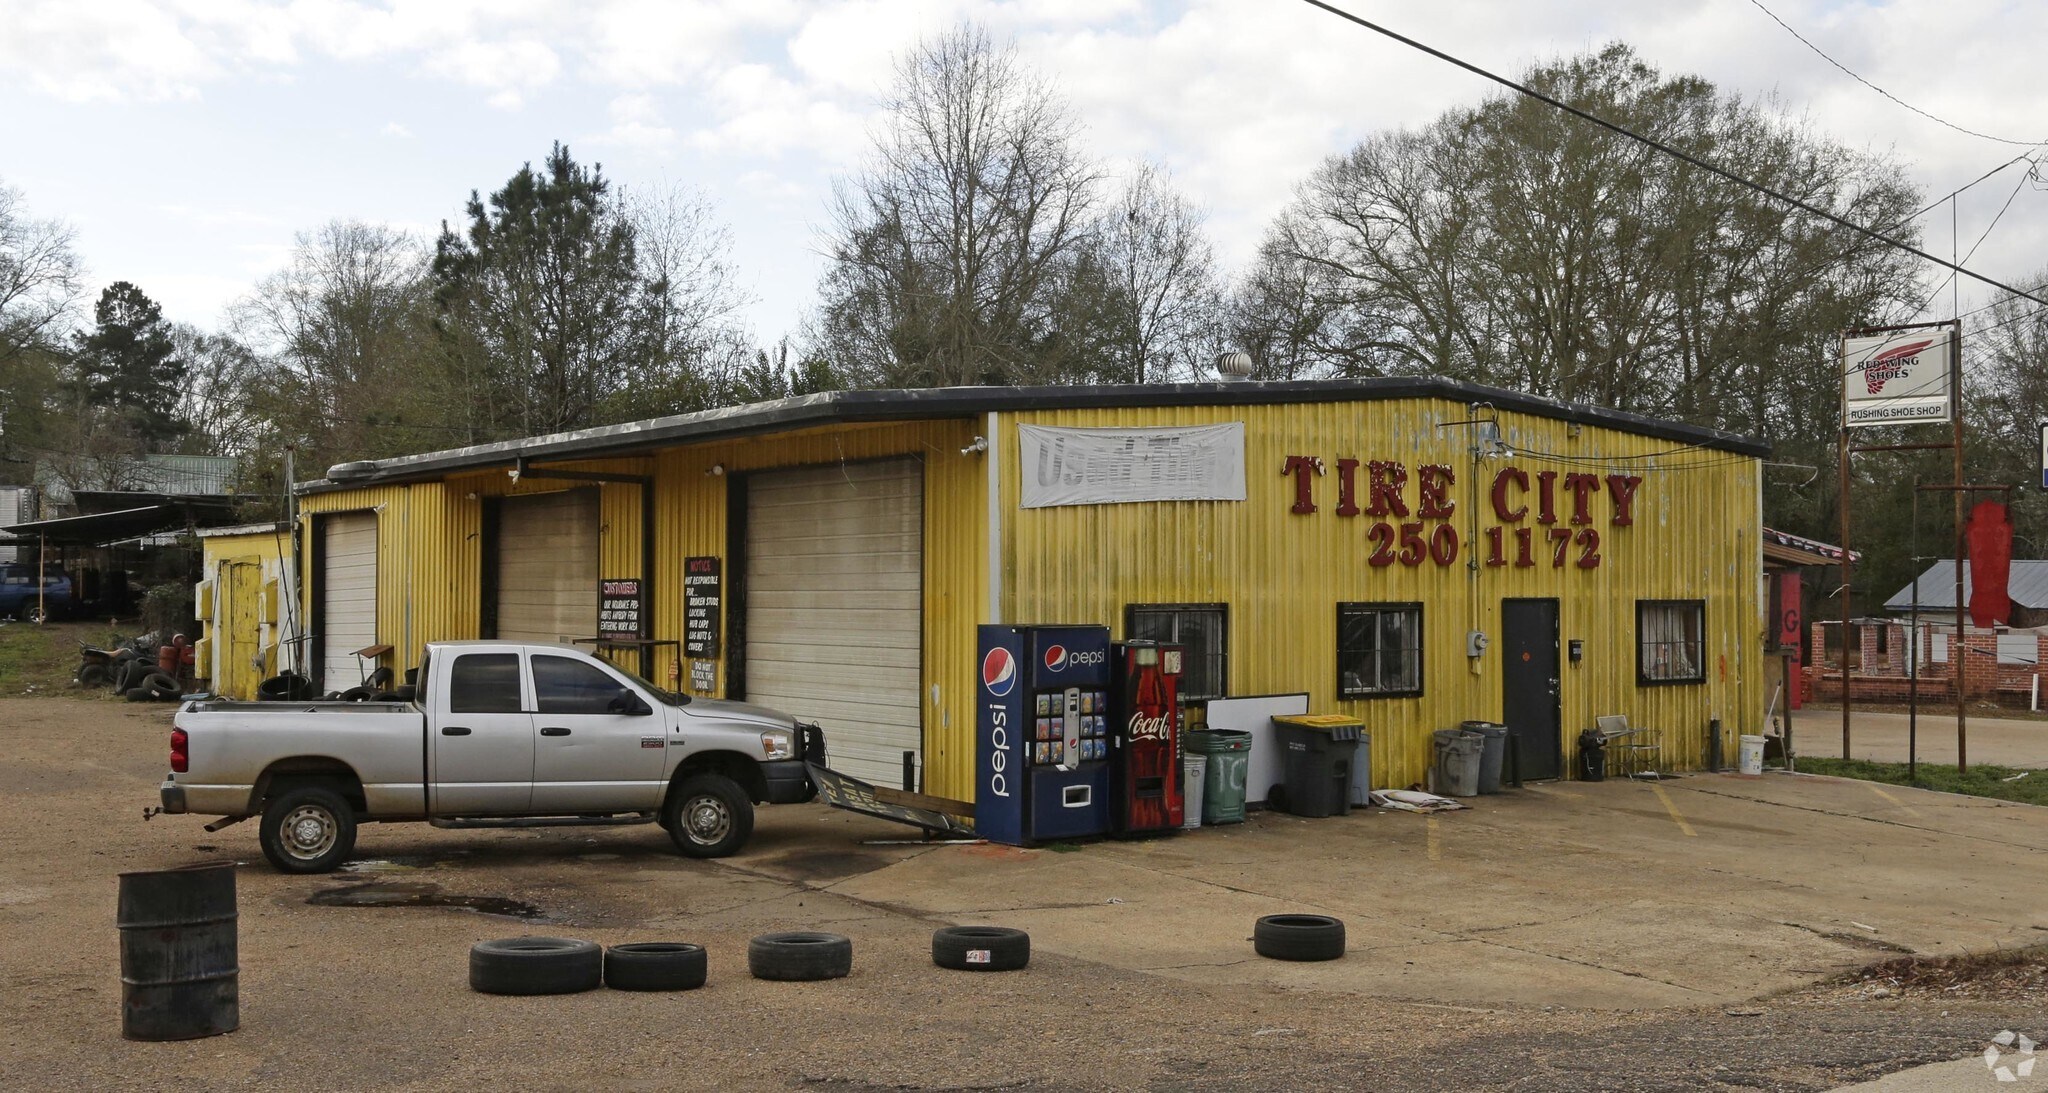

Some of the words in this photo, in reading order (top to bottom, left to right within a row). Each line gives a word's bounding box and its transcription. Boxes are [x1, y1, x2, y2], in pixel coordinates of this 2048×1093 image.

[1857, 360, 1881, 371] RED
[1884, 356, 1919, 369] WING
[1868, 369, 1909, 381] SHOES
[1851, 408, 1889, 419] RUSHING
[1891, 407, 1915, 417] SHOE
[1916, 406, 1942, 416] SHOP
[1281, 455, 1457, 518] TIRE
[1491, 466, 1643, 526] CITY
[1368, 521, 1458, 567] 250
[1486, 526, 1601, 568] 1172
[690, 560, 712, 573] NOTICE
[693, 575, 719, 585] RESPONSIBLE
[603, 581, 638, 595] CUSTOMERS
[689, 597, 706, 606] BROKEN
[706, 597, 719, 606] STUDS
[689, 608, 706, 618] LOCKING
[600, 621, 618, 631] ENTERING
[618, 621, 629, 631] WORK
[629, 621, 638, 632] AREA
[689, 620, 698, 629] HUB
[698, 620, 709, 629] CAPS
[689, 631, 697, 640] LUG
[697, 631, 707, 641] NUTS
[688, 642, 704, 652] COVERS
[1069, 648, 1105, 668] pepsi
[695, 661, 702, 670] DO
[702, 662, 711, 672] NOT
[691, 670, 705, 679] BLOCK
[705, 671, 714, 681] THE
[695, 680, 708, 689] DOOR
[989, 704, 1009, 797] pepsi
